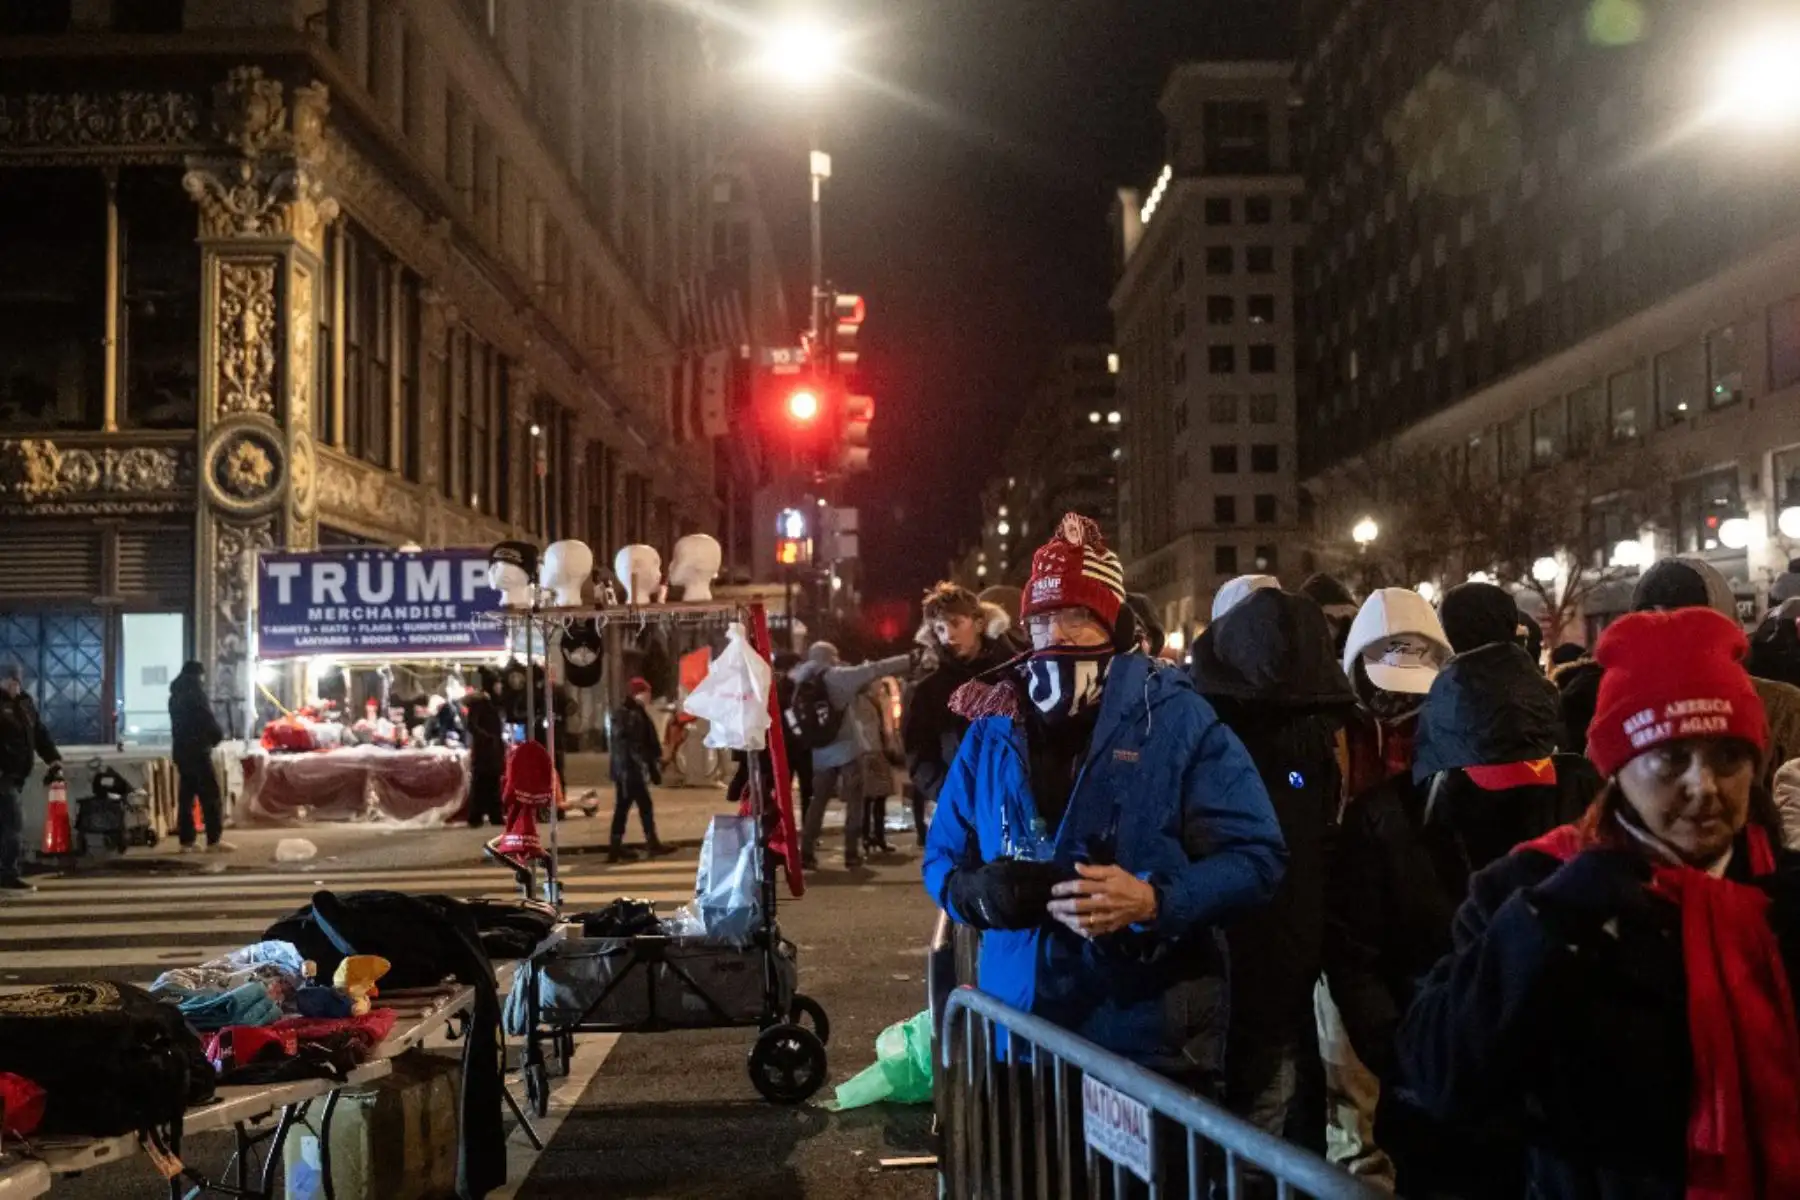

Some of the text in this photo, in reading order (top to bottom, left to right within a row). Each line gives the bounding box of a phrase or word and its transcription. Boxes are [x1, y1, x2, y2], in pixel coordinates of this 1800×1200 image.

[267, 559, 490, 605] TRUMP
[307, 604, 457, 621] MERCHANDISE
[358, 623, 393, 633] FLAGS
[402, 622, 447, 631] BUMPER
[361, 635, 400, 645] BOOKS
[408, 633, 470, 644] SOUVENIRS
[1622, 698, 1733, 736] MAKE AMERICA
[1630, 716, 1728, 748] GREAT AGAIN
